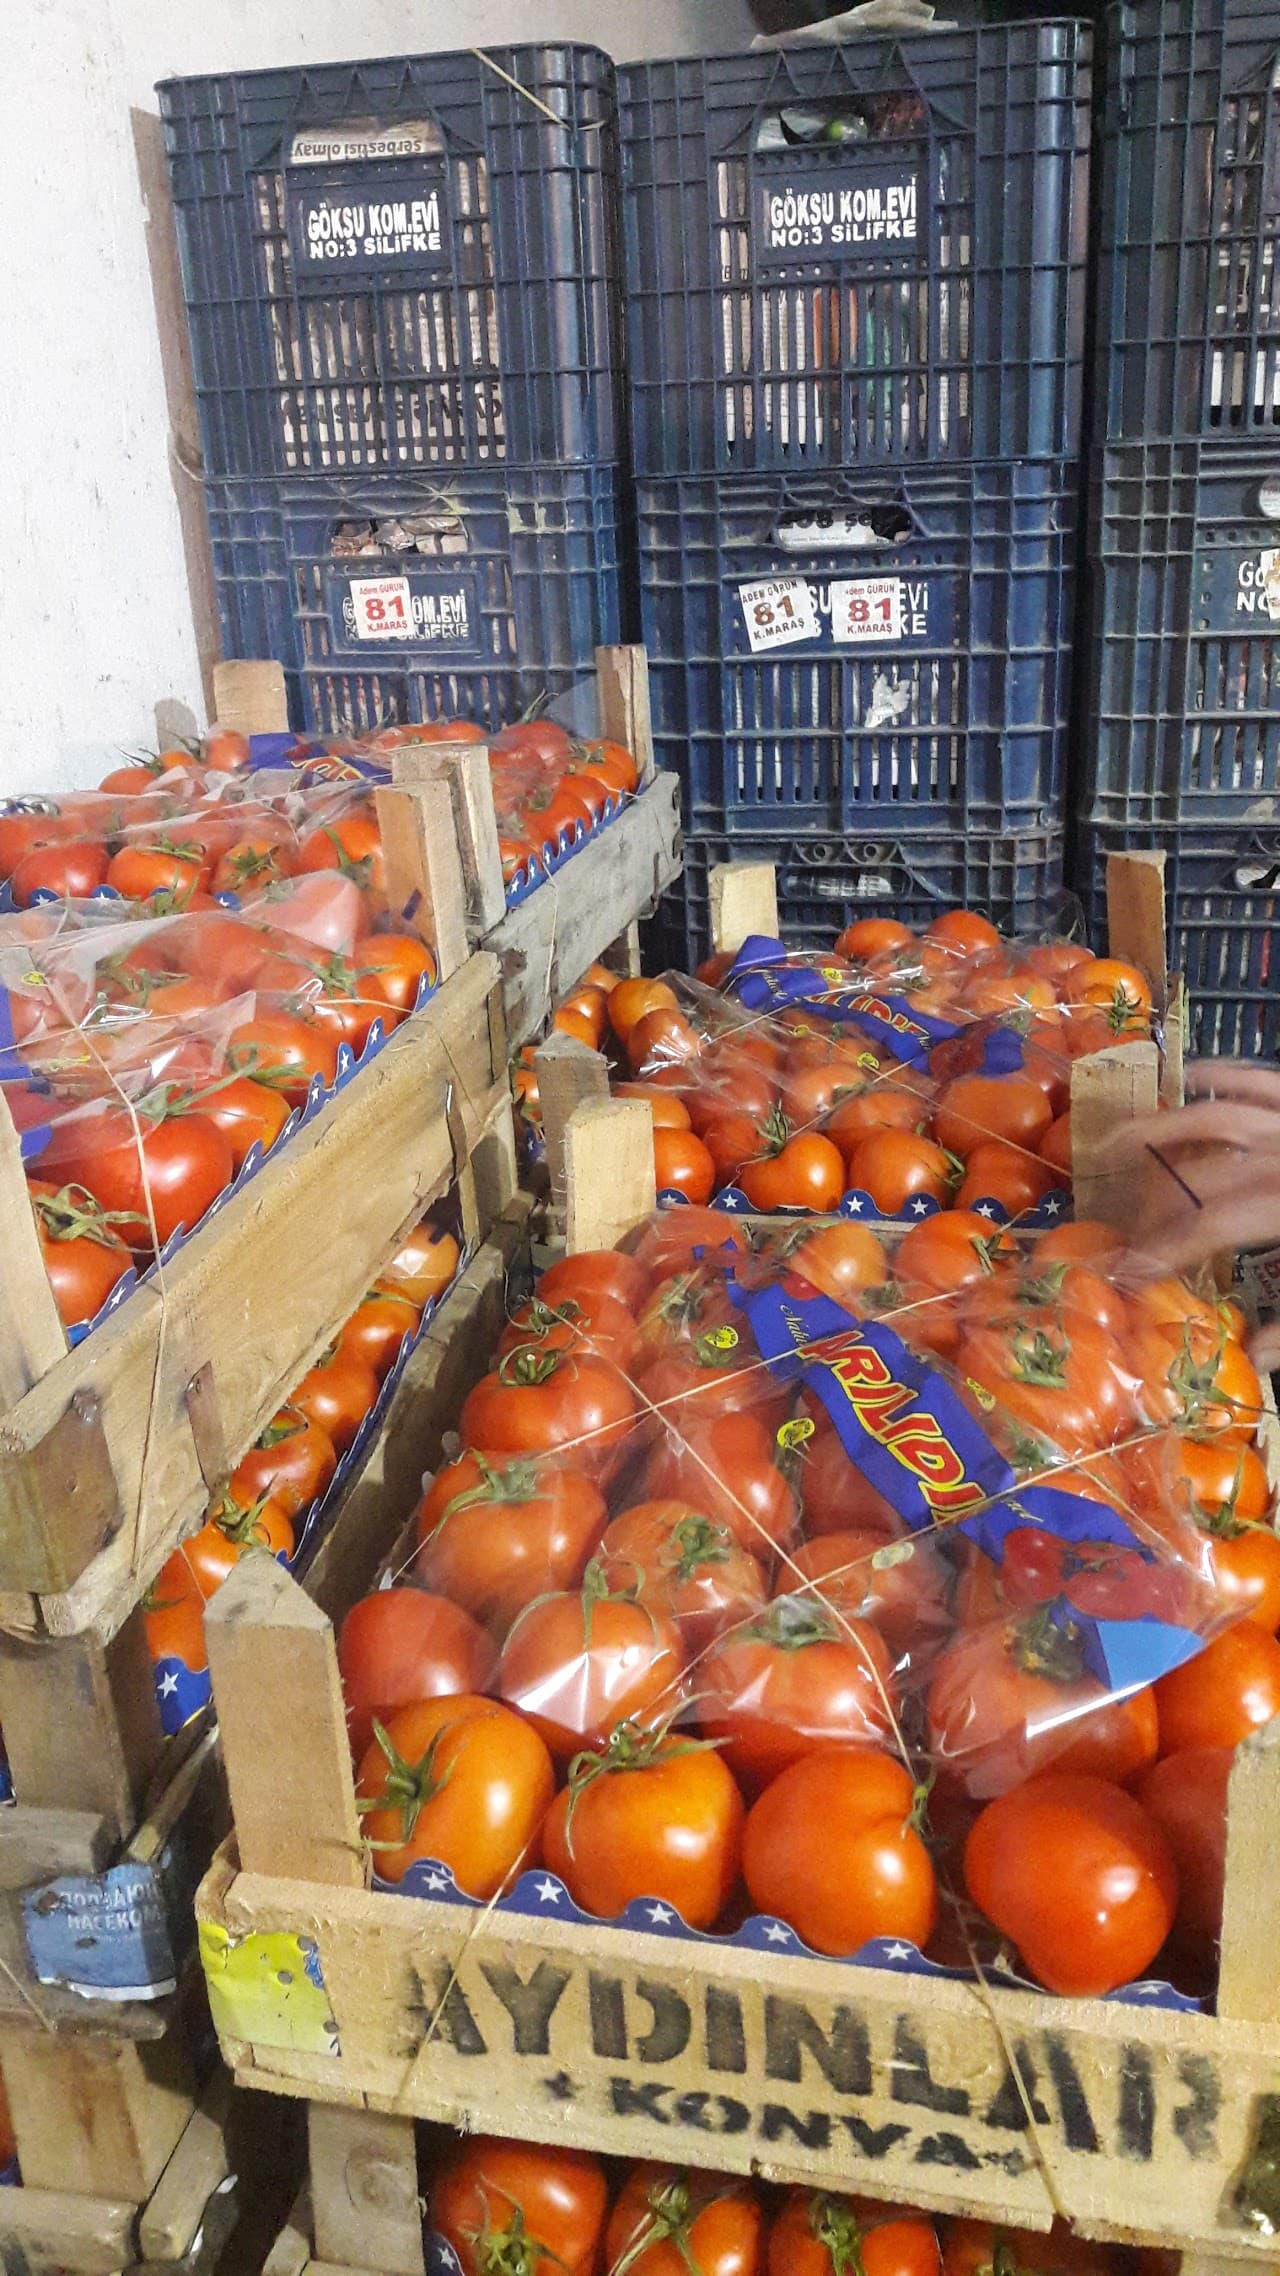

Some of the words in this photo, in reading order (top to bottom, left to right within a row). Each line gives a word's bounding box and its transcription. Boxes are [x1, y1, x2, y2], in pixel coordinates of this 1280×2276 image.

[308, 202, 365, 241] GÖKSU
[771, 187, 834, 228] GÖKSU
[309, 238, 357, 260] NO:3
[771, 226, 823, 248] NO:3
[365, 595, 405, 621] 81
[753, 595, 795, 626] 81
[847, 597, 892, 622] 81
[393, 1952, 1223, 2162] AYDINLAR
[609, 2074, 982, 2170] KONYA
